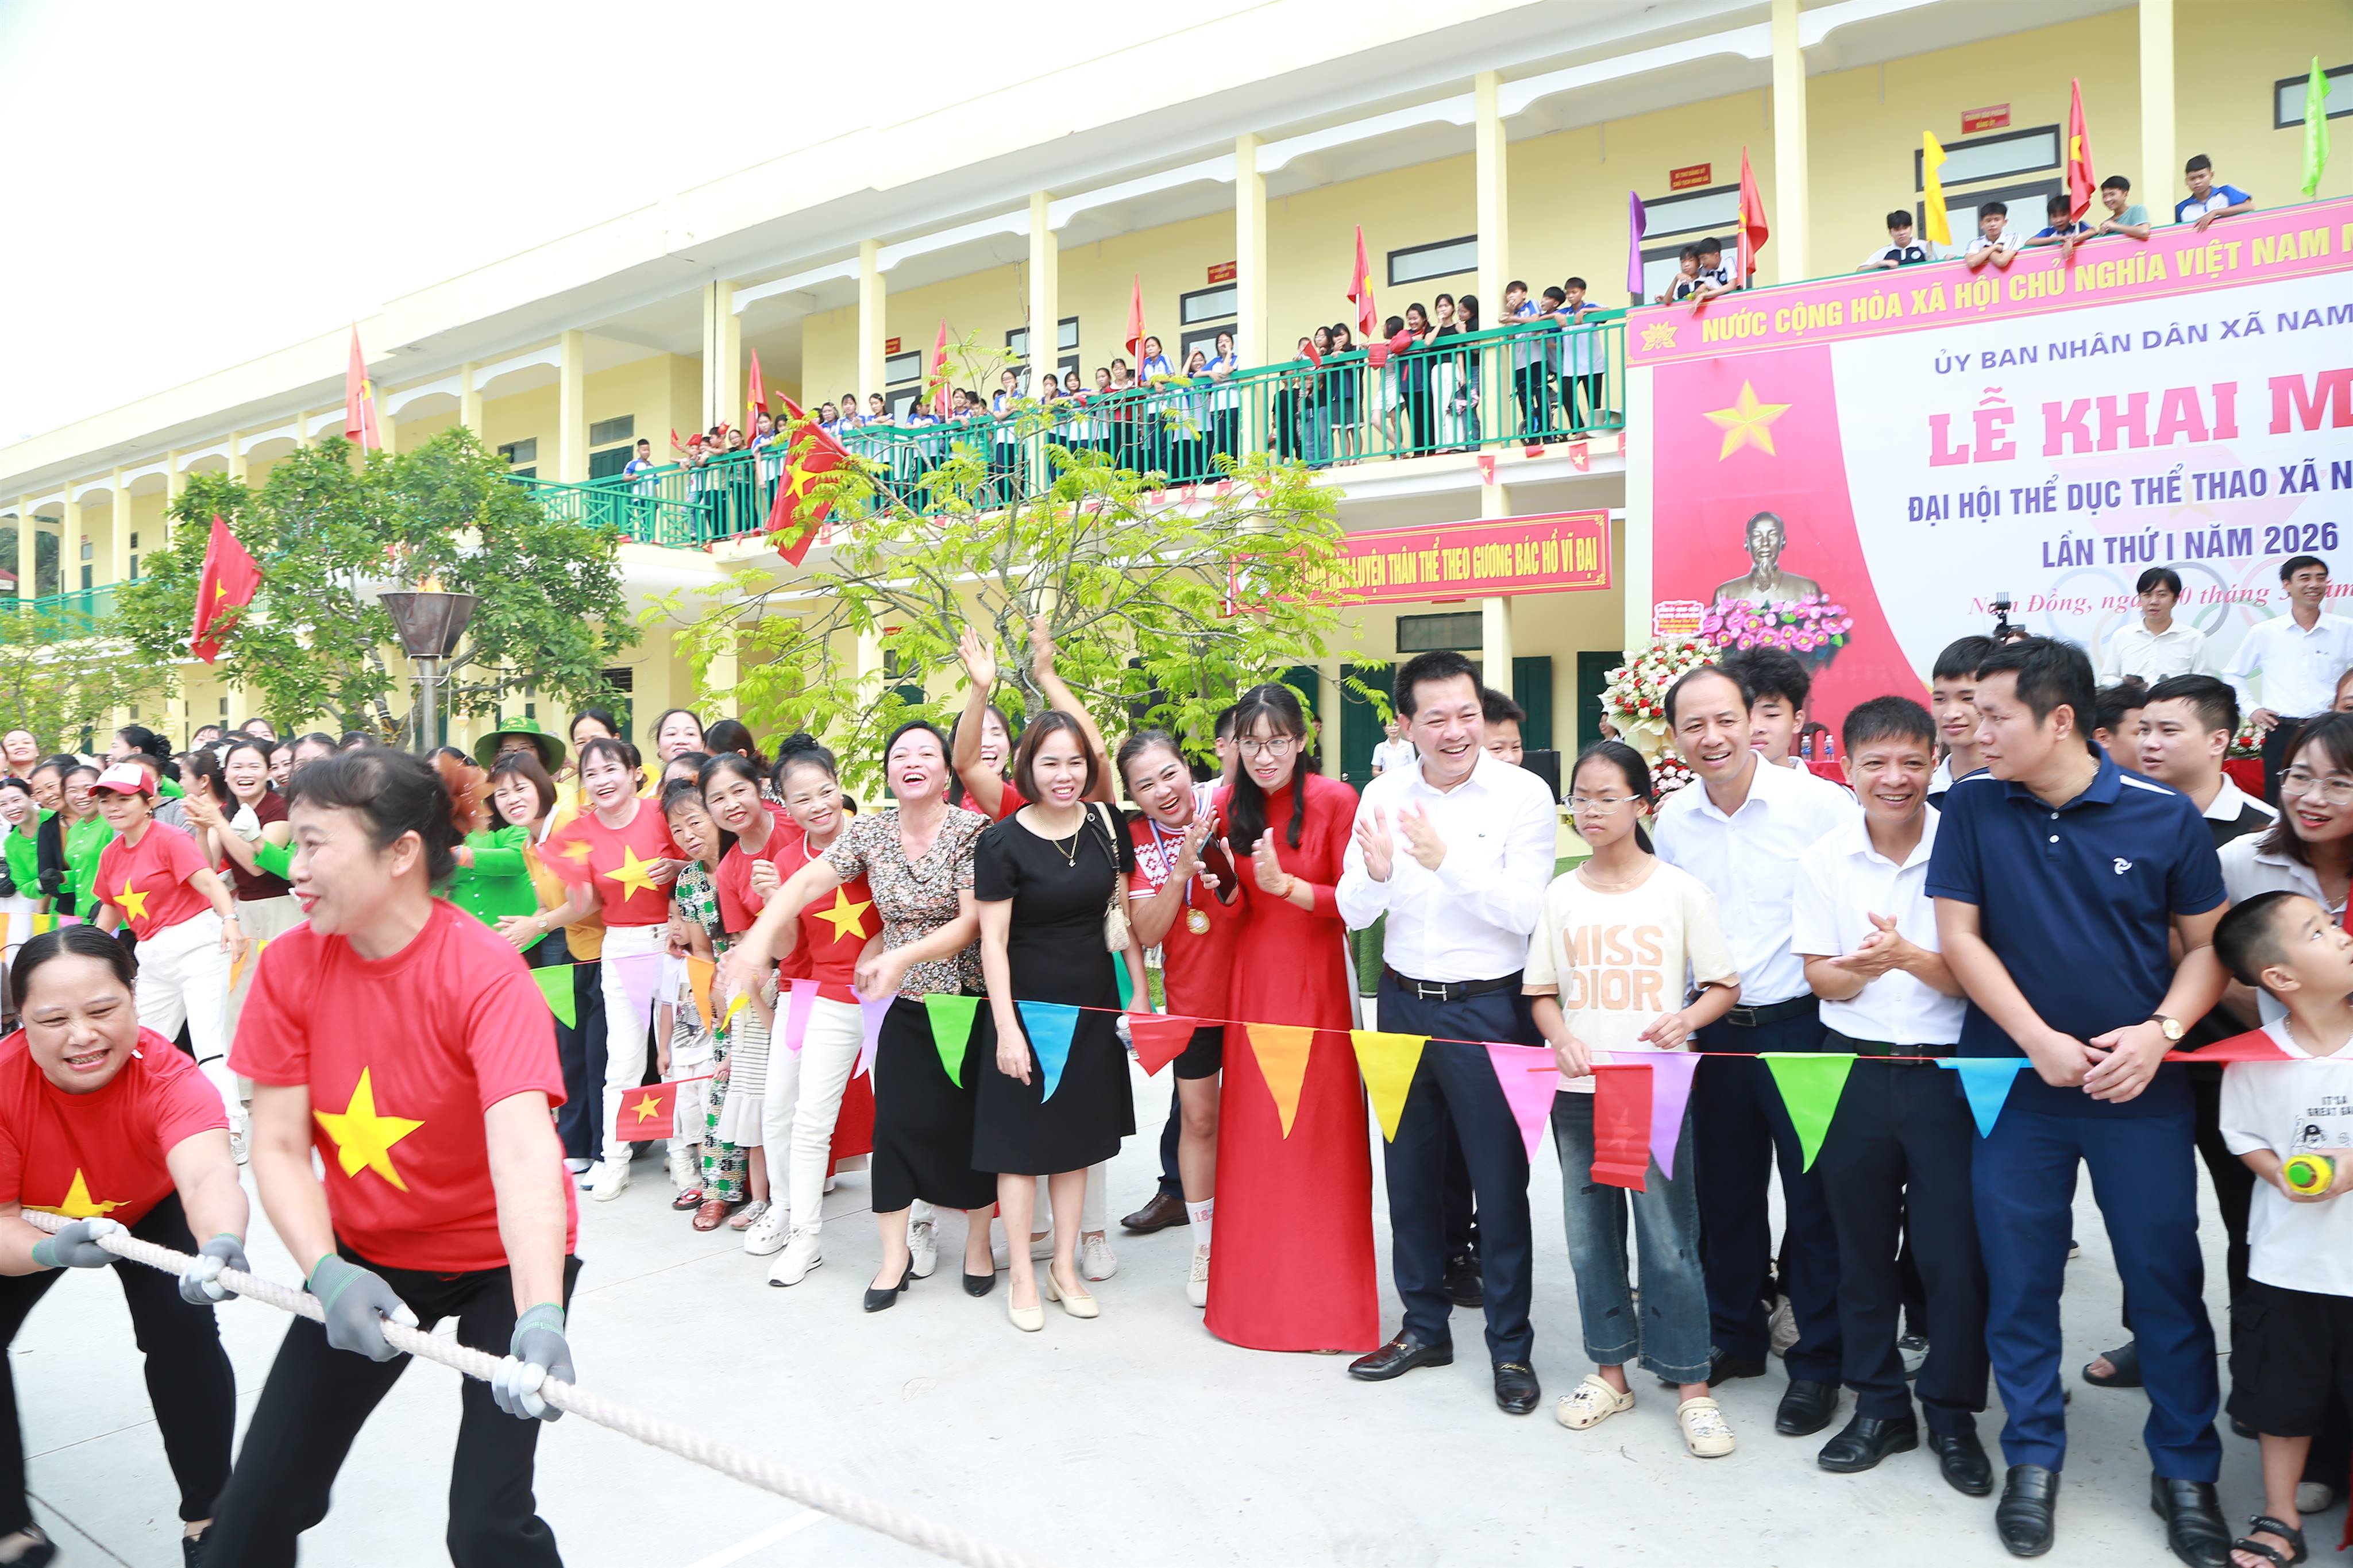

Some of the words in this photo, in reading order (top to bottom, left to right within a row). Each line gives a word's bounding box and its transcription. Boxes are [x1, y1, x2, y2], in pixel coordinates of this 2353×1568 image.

[1702, 307, 1768, 343] NƯỚC
[1775, 300, 1844, 337] CỘNG
[1851, 289, 1903, 323] HÒA
[1911, 281, 1946, 315] XÃ
[1955, 273, 2000, 313] HỘI
[2008, 257, 2066, 301] CHỦ
[2075, 250, 2167, 292] NGHĨA
[2176, 238, 2243, 279] VIỆT
[2252, 226, 2331, 267] NAM
[1935, 350, 1972, 374] ỦY
[1981, 346, 2038, 369] BAN
[2049, 331, 2131, 361] NHÂN
[2143, 321, 2208, 349] DÂN
[2219, 311, 2266, 340] XÃ
[2278, 303, 2353, 332] NAM
[1930, 386, 2017, 467] LỄ
[2042, 381, 2239, 457] KHAI
[1908, 494, 1949, 526] ĐẠI
[1959, 485, 2000, 523] HỘI
[2010, 474, 2058, 515] THỂ
[2068, 480, 2120, 515] DỤC
[2132, 463, 2184, 505] THỂ
[2192, 468, 2267, 501] THAO
[2278, 457, 2319, 495] XÃ
[1387, 545, 1417, 585] THÂN
[1418, 535, 1440, 583] THỂ
[1441, 546, 1471, 581] THEO
[1472, 542, 1513, 580] GƯƠNG
[1515, 535, 1540, 576] BÁC
[1542, 528, 1559, 574] HỒ
[1561, 531, 1574, 573] VĨ
[1576, 536, 1598, 579] ĐẠI
[2042, 530, 2093, 567] LẦN
[2104, 526, 2159, 564] THỨ
[2167, 533, 2174, 560] I
[2185, 523, 2252, 559] NĂM
[2264, 522, 2338, 555] 2026
[2026, 588, 2093, 615] Đồng,
[2200, 584, 2271, 607] tháng
[1563, 924, 1664, 967] MISS
[1567, 968, 1664, 1012] DIOR
